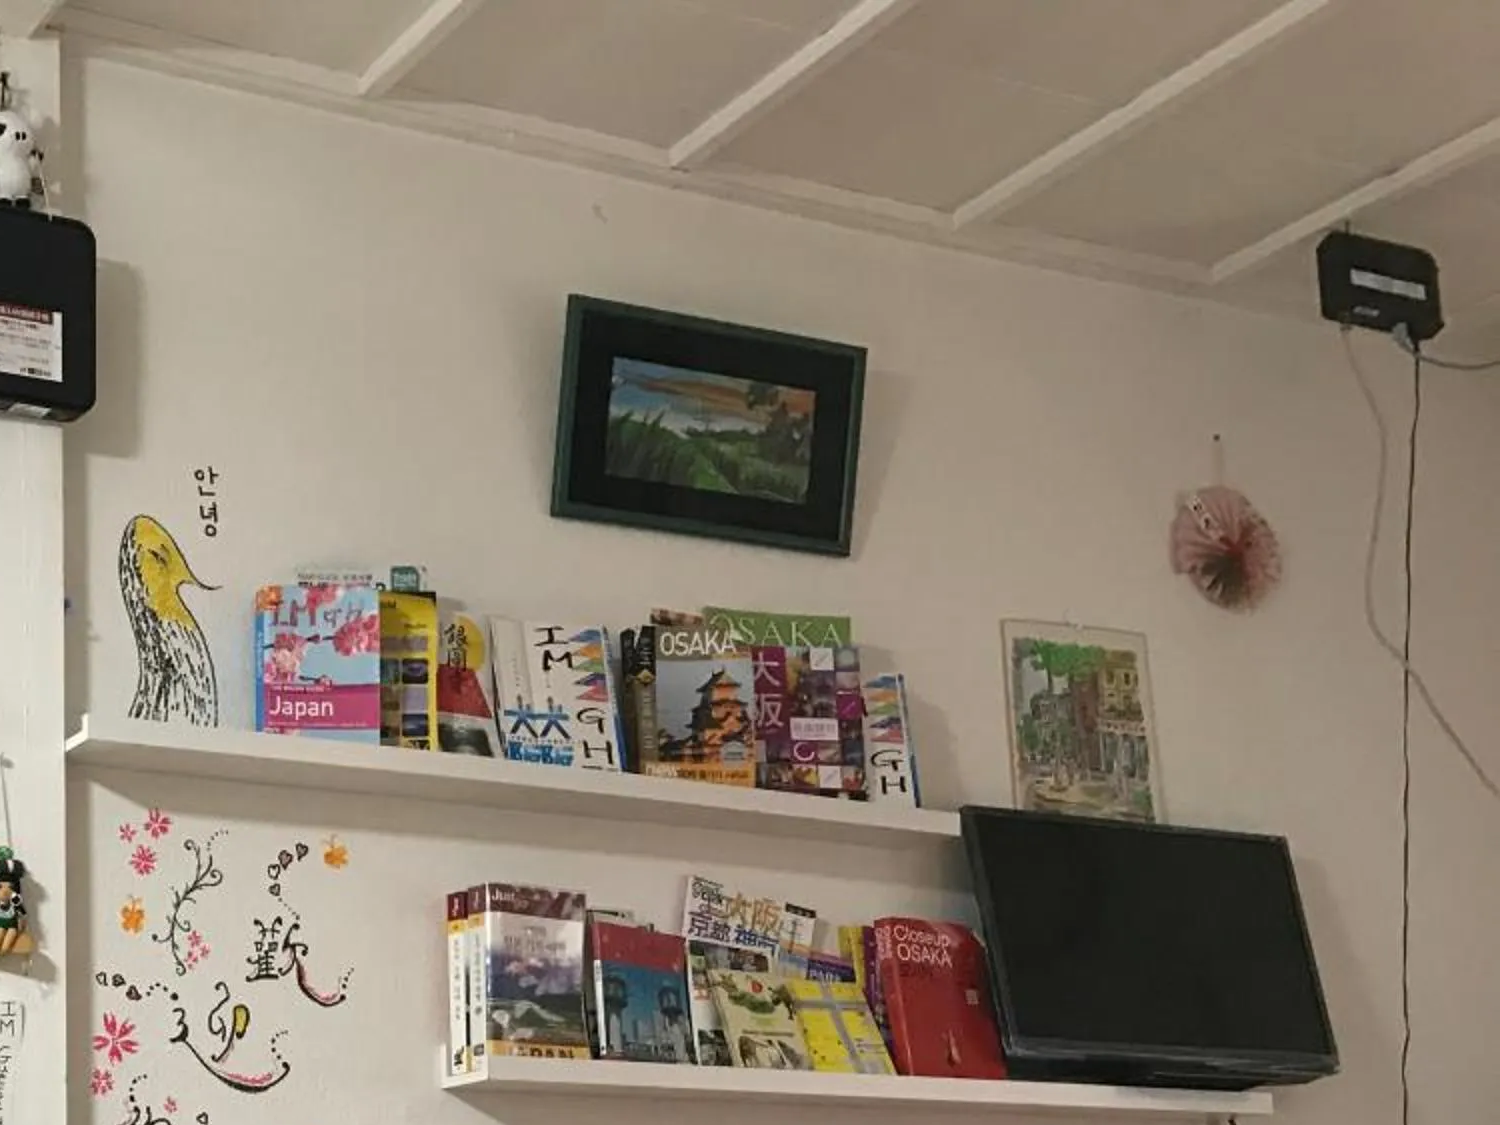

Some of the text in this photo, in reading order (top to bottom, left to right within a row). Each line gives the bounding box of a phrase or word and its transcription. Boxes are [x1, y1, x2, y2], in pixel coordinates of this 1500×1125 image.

[659, 630, 736, 657] OSAKA
[269, 695, 334, 720] Japan
[897, 943, 953, 969] OSAKA
